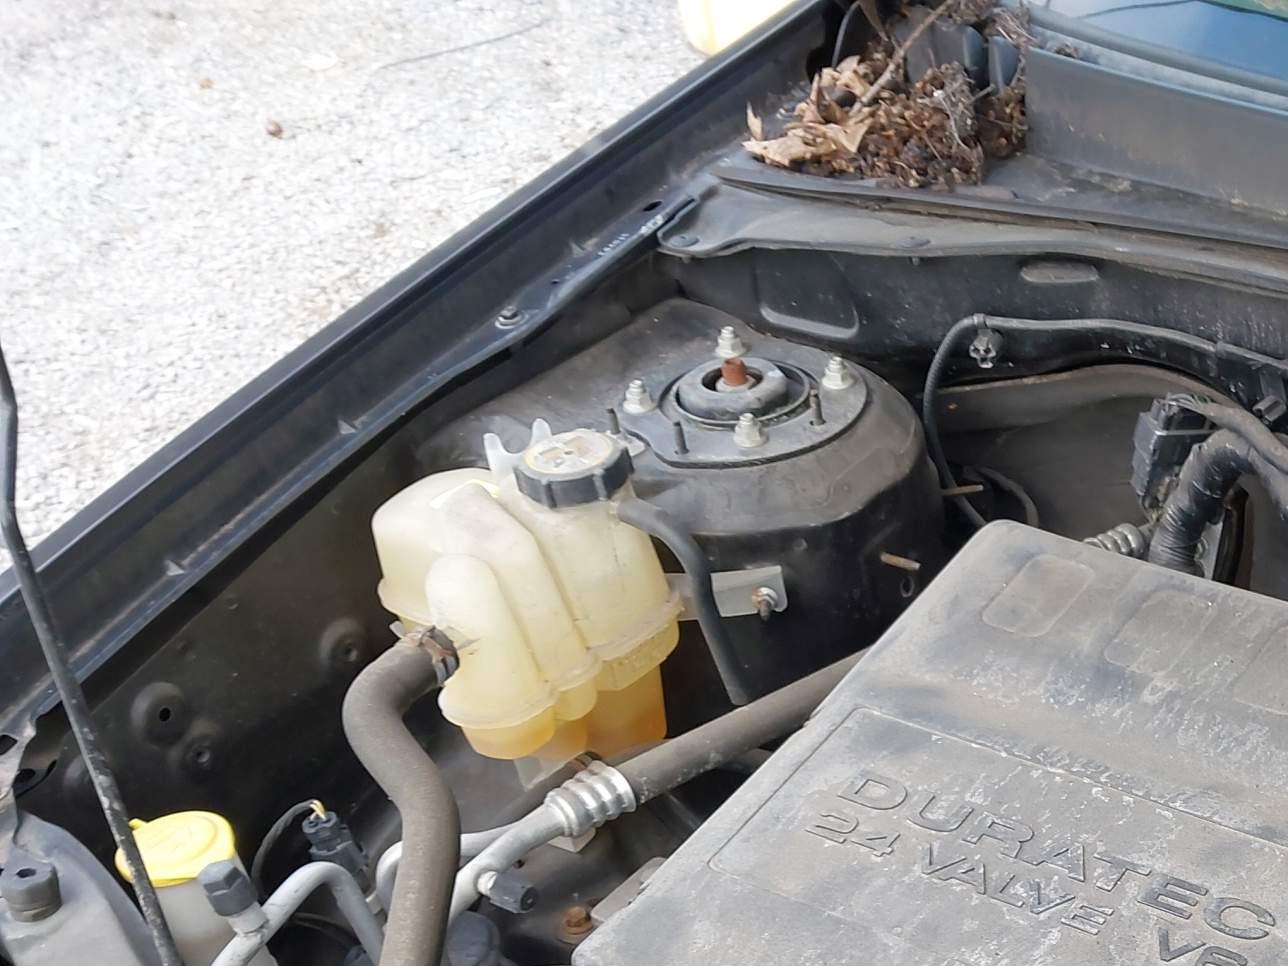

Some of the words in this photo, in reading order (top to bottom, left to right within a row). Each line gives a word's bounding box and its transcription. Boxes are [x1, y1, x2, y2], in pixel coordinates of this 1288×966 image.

[805, 812, 902, 858] 24
[921, 841, 1115, 936] VALVE
[837, 774, 1277, 941] DURATEC
